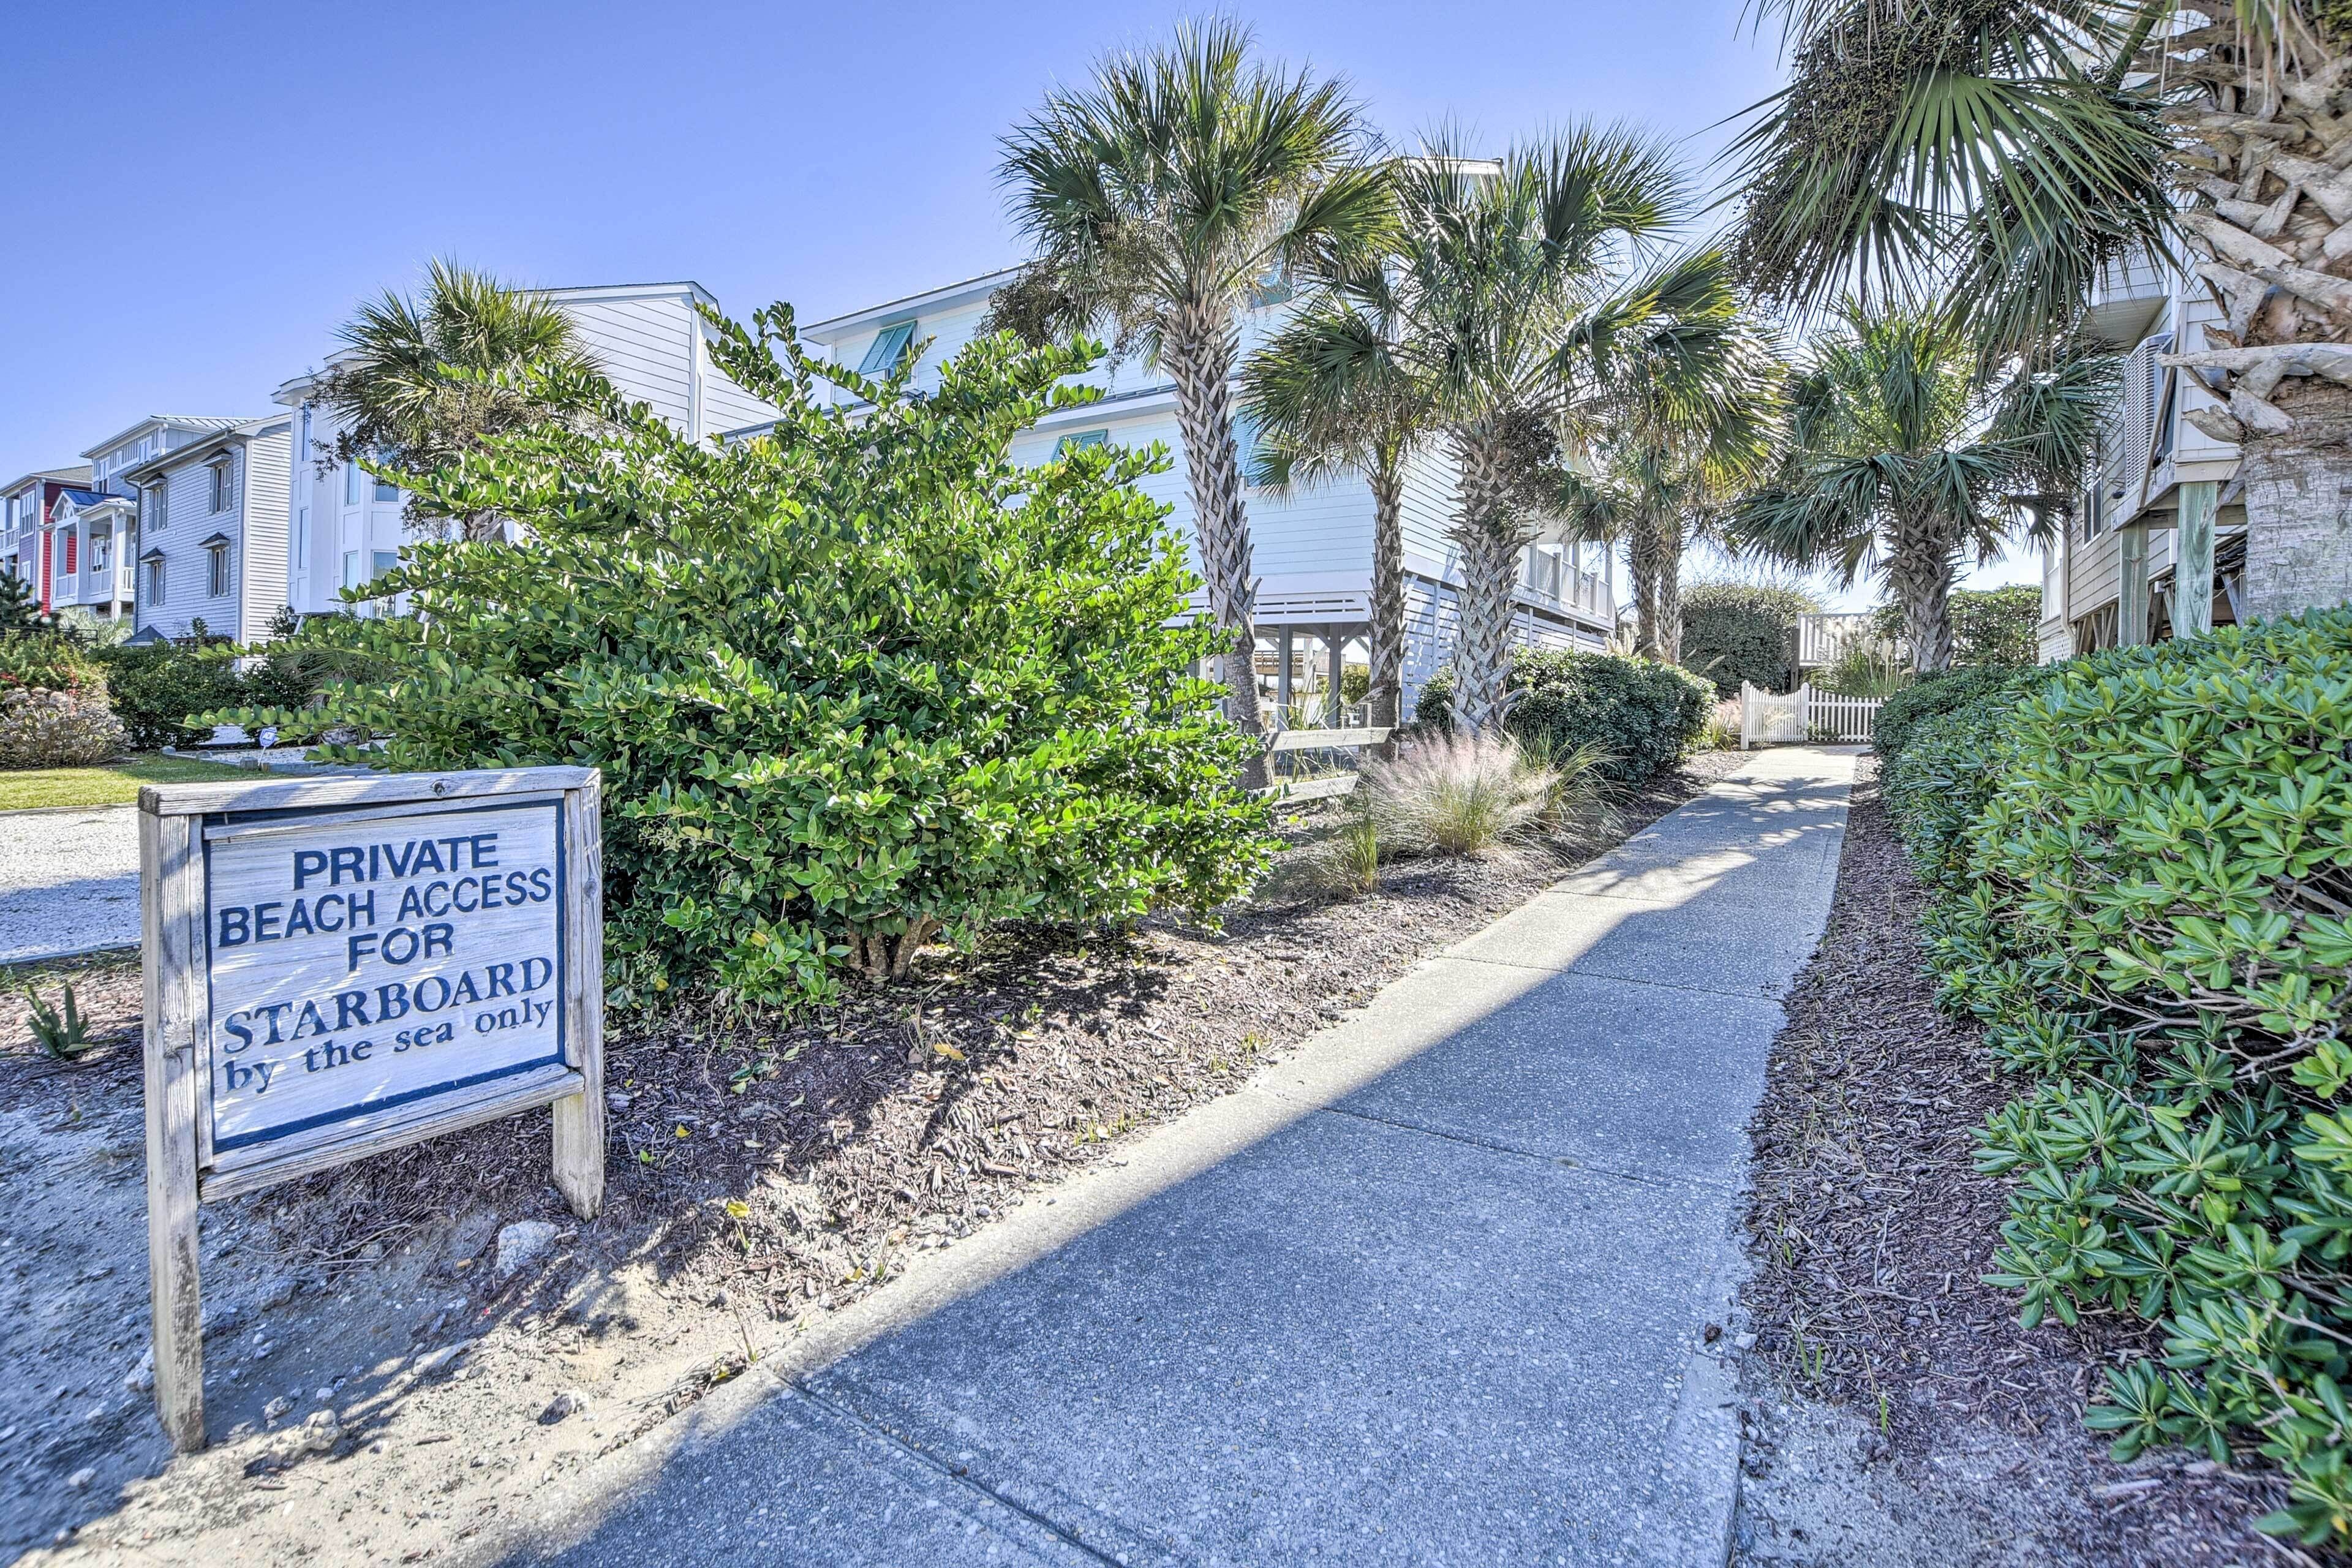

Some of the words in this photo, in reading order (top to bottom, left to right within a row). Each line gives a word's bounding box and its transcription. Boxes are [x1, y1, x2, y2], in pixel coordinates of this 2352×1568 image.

[293, 833, 498, 890] PRIVATE
[219, 889, 375, 947] BEACH
[397, 868, 551, 922] ACCESS
[349, 922, 454, 971] FOR
[224, 957, 552, 1054] STARBOARD
[223, 1060, 279, 1094] by
[304, 1039, 372, 1072] the
[393, 1022, 454, 1052] sea
[475, 998, 553, 1033] only
